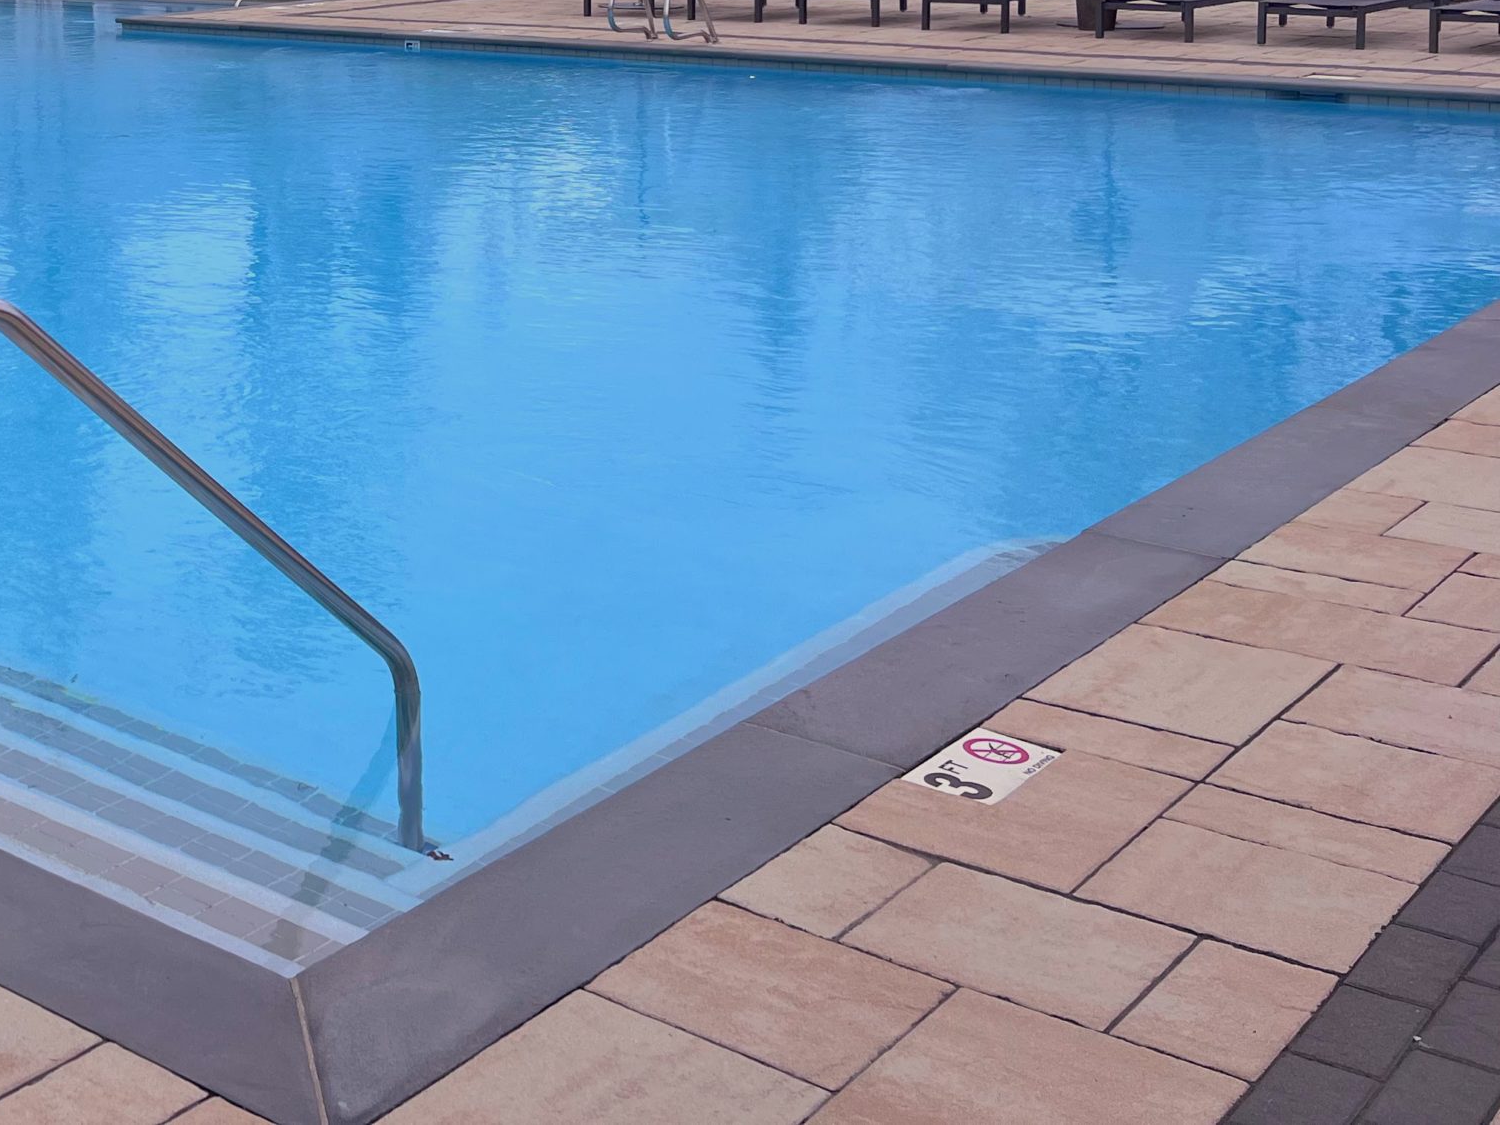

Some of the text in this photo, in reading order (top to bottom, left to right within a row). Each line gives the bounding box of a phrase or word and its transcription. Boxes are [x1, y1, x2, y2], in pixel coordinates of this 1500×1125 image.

[923, 759, 993, 800] 3 FT
[1023, 767, 1037, 776] NO
